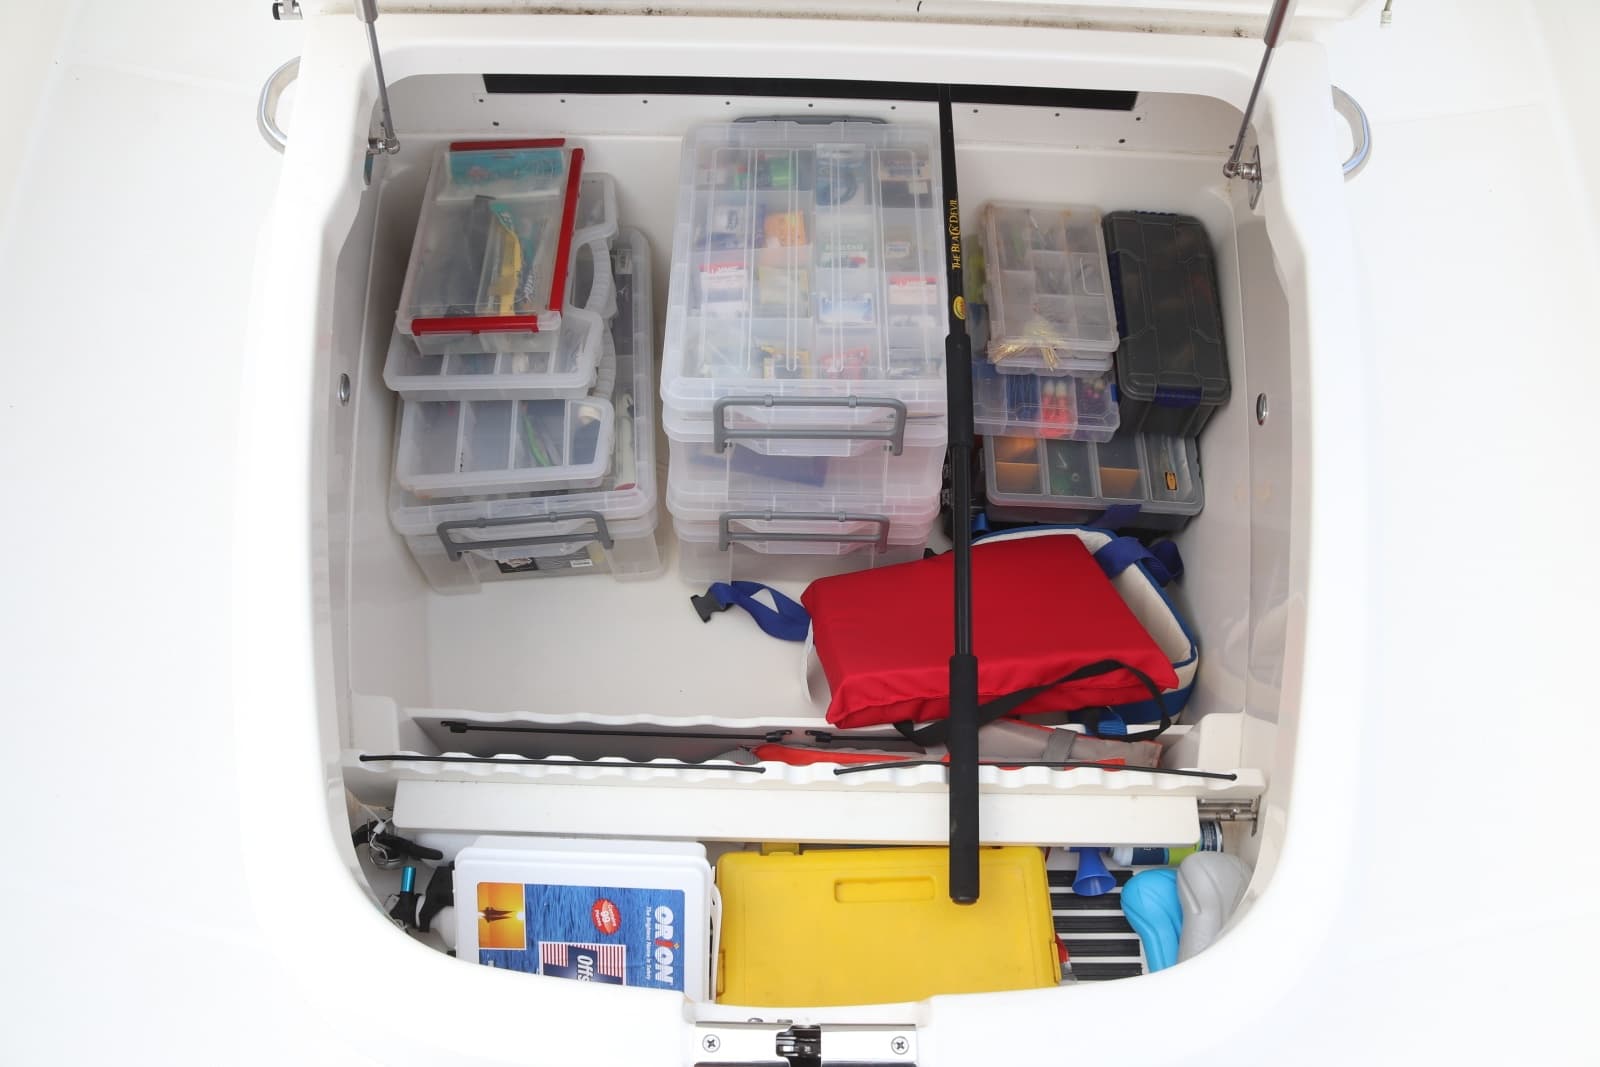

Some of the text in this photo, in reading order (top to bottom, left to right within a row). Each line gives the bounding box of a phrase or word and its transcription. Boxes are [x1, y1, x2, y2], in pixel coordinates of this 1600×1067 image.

[949, 199, 960, 270] THE BLACK DEVIL
